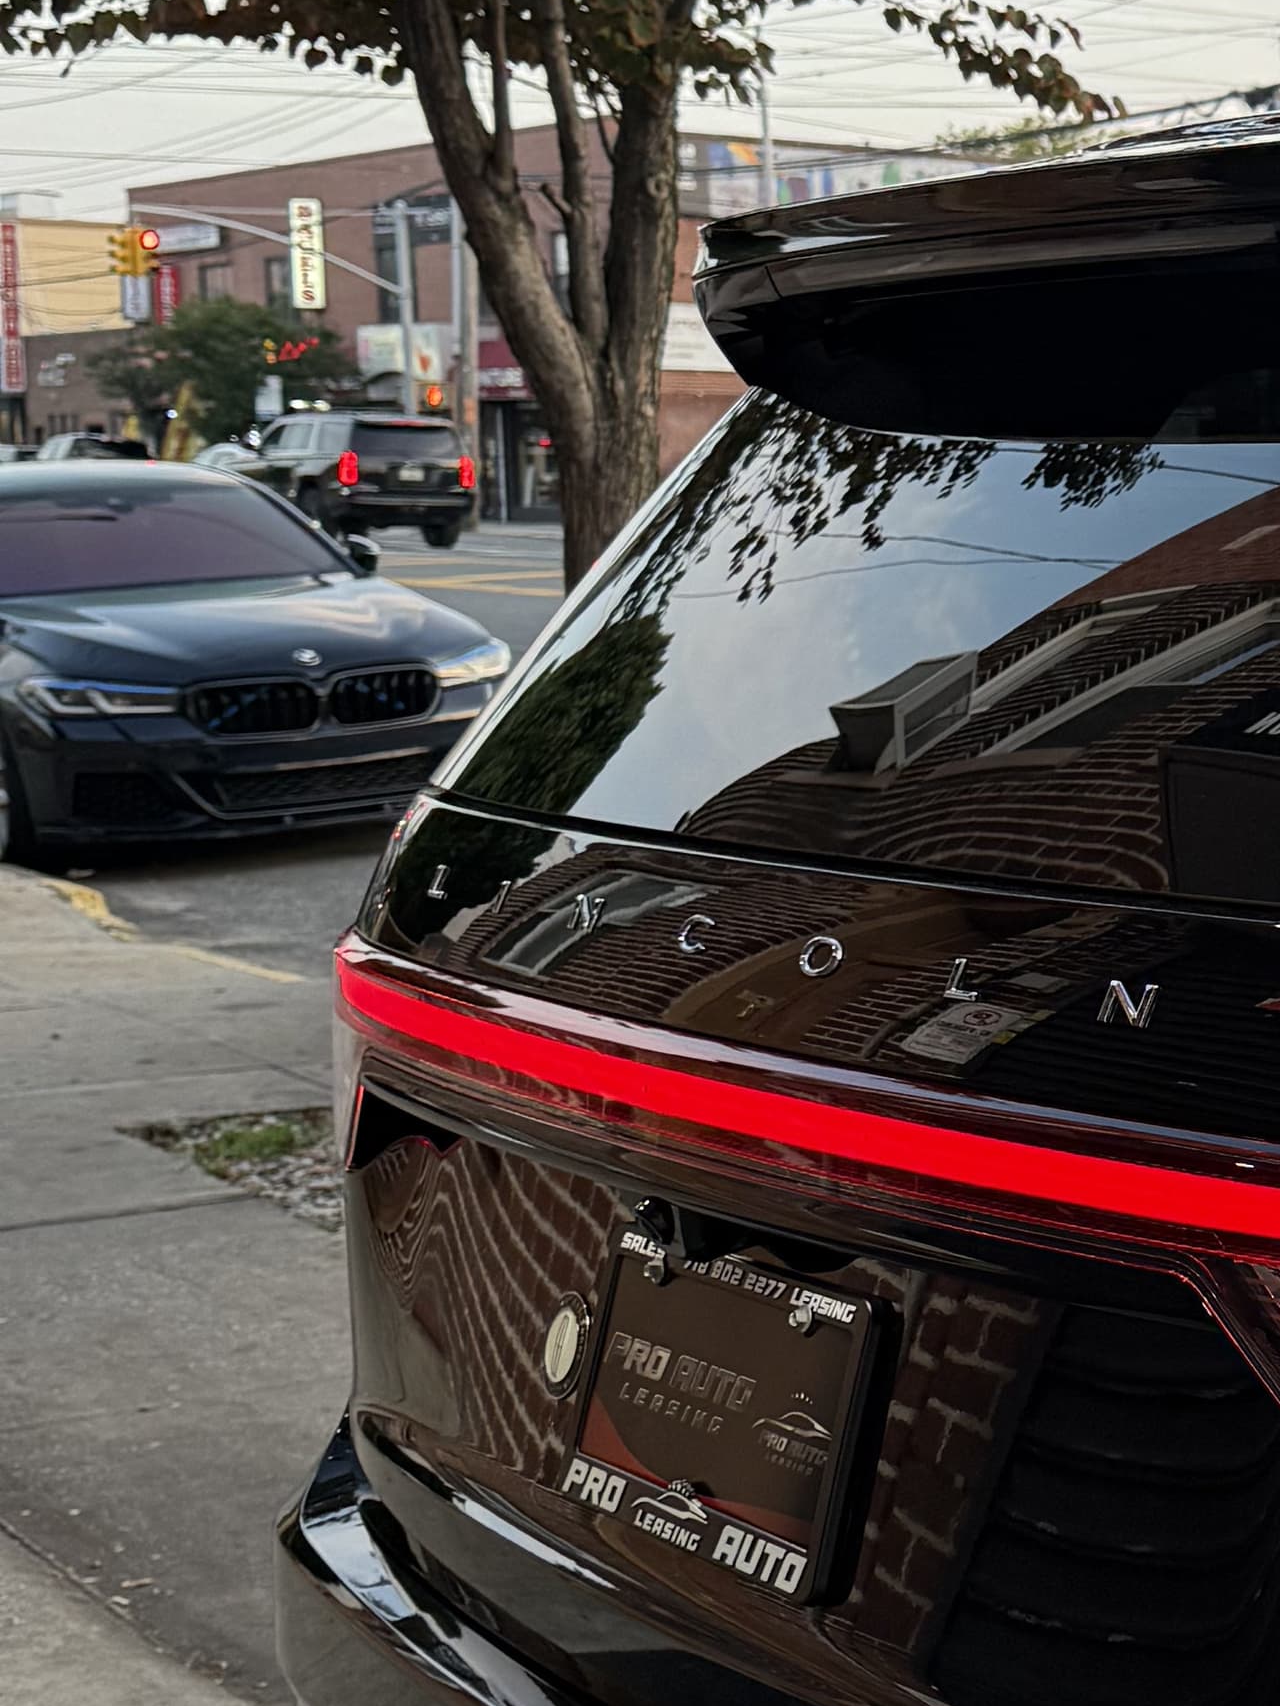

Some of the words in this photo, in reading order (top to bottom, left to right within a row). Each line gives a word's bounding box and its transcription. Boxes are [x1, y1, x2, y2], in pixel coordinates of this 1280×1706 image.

[427, 864, 1160, 1029] LINCOLN
[620, 1231, 666, 1260] SALES
[710, 1260, 744, 1286] 802
[746, 1273, 787, 1300] 2277
[788, 1287, 858, 1324] LEASING
[603, 1331, 673, 1382] PRO
[668, 1354, 758, 1413] AUTO
[619, 1381, 725, 1435] LEASING
[561, 1457, 628, 1514] PRO
[711, 1524, 808, 1594] AUTO
[633, 1507, 703, 1553] LEASING
